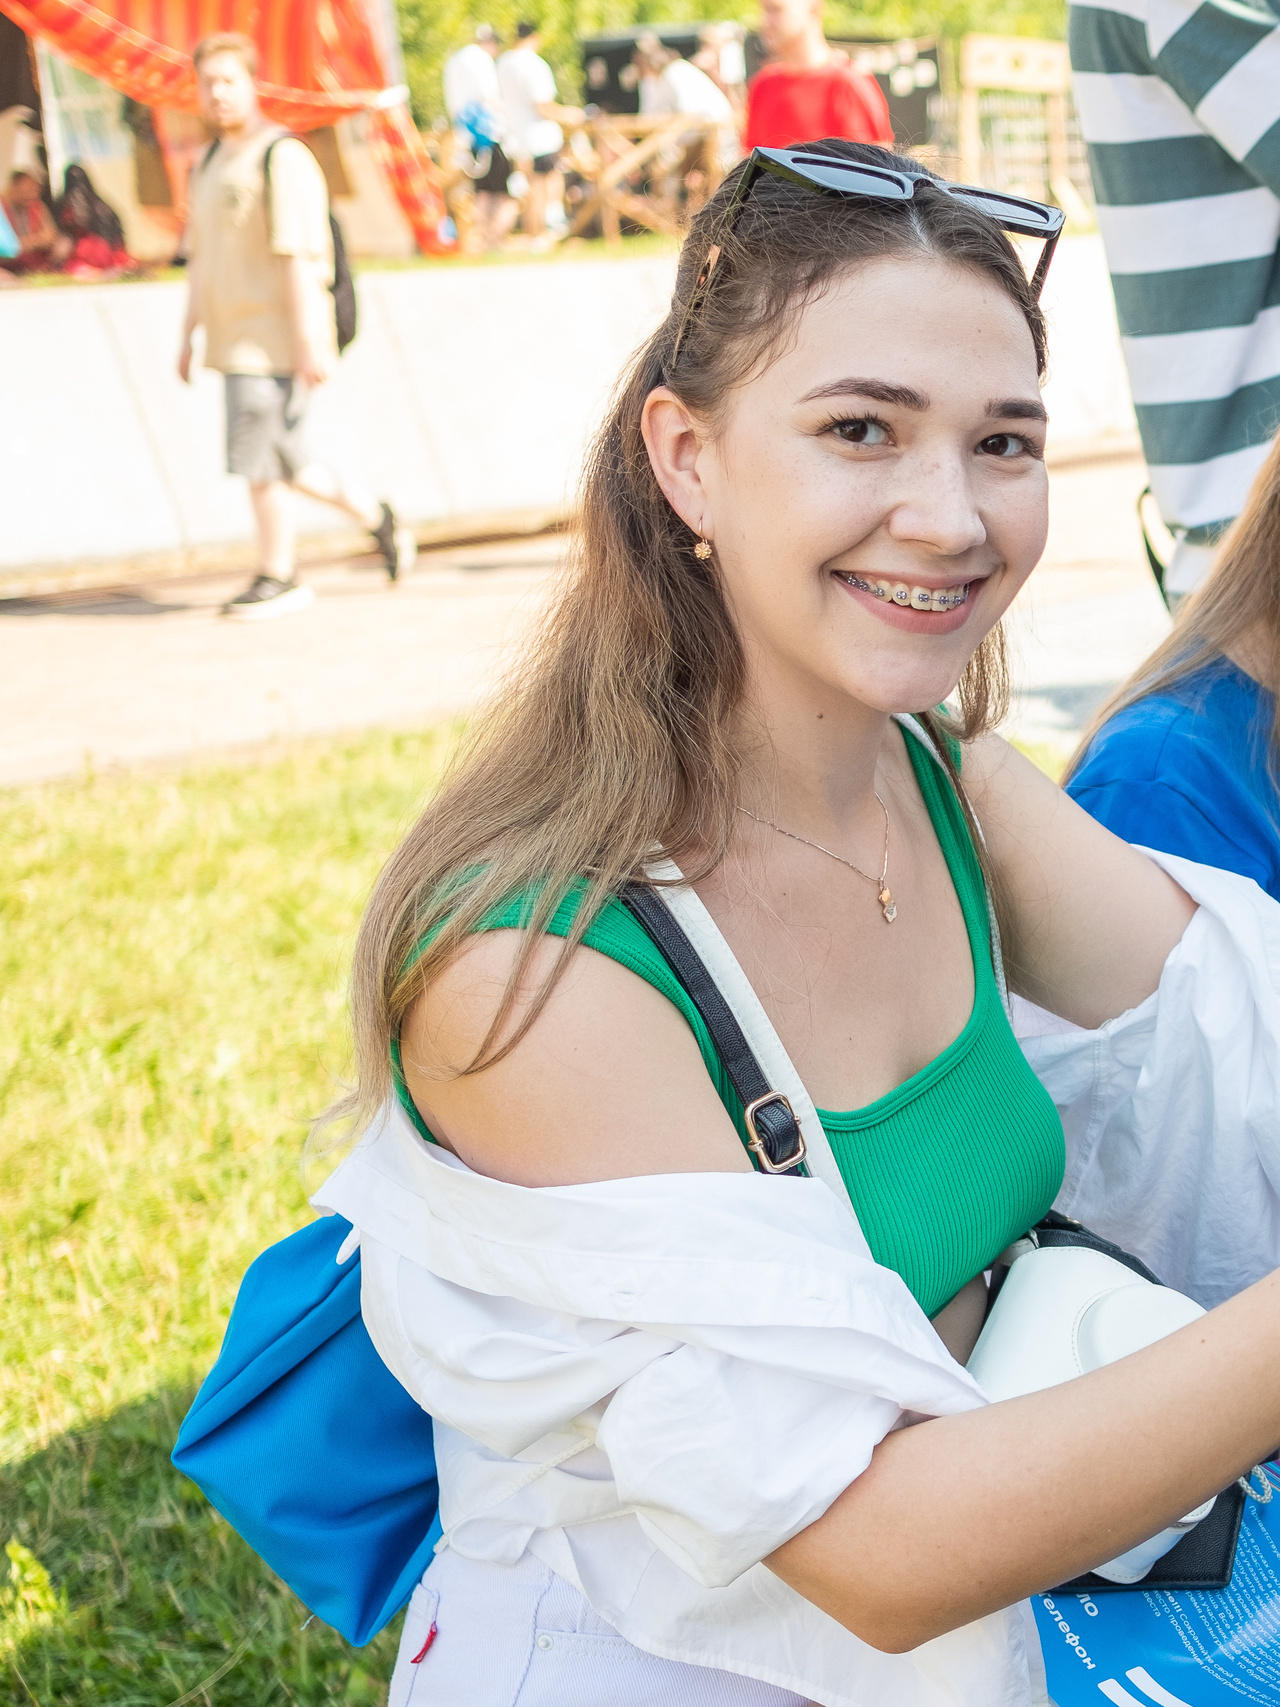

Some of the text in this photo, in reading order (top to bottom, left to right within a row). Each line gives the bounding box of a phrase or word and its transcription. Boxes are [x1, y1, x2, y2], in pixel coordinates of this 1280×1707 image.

[1252, 1543, 1270, 1569] руках
[1140, 1589, 1161, 1617] веста
[1178, 1612, 1215, 1664] Сохраняйте
